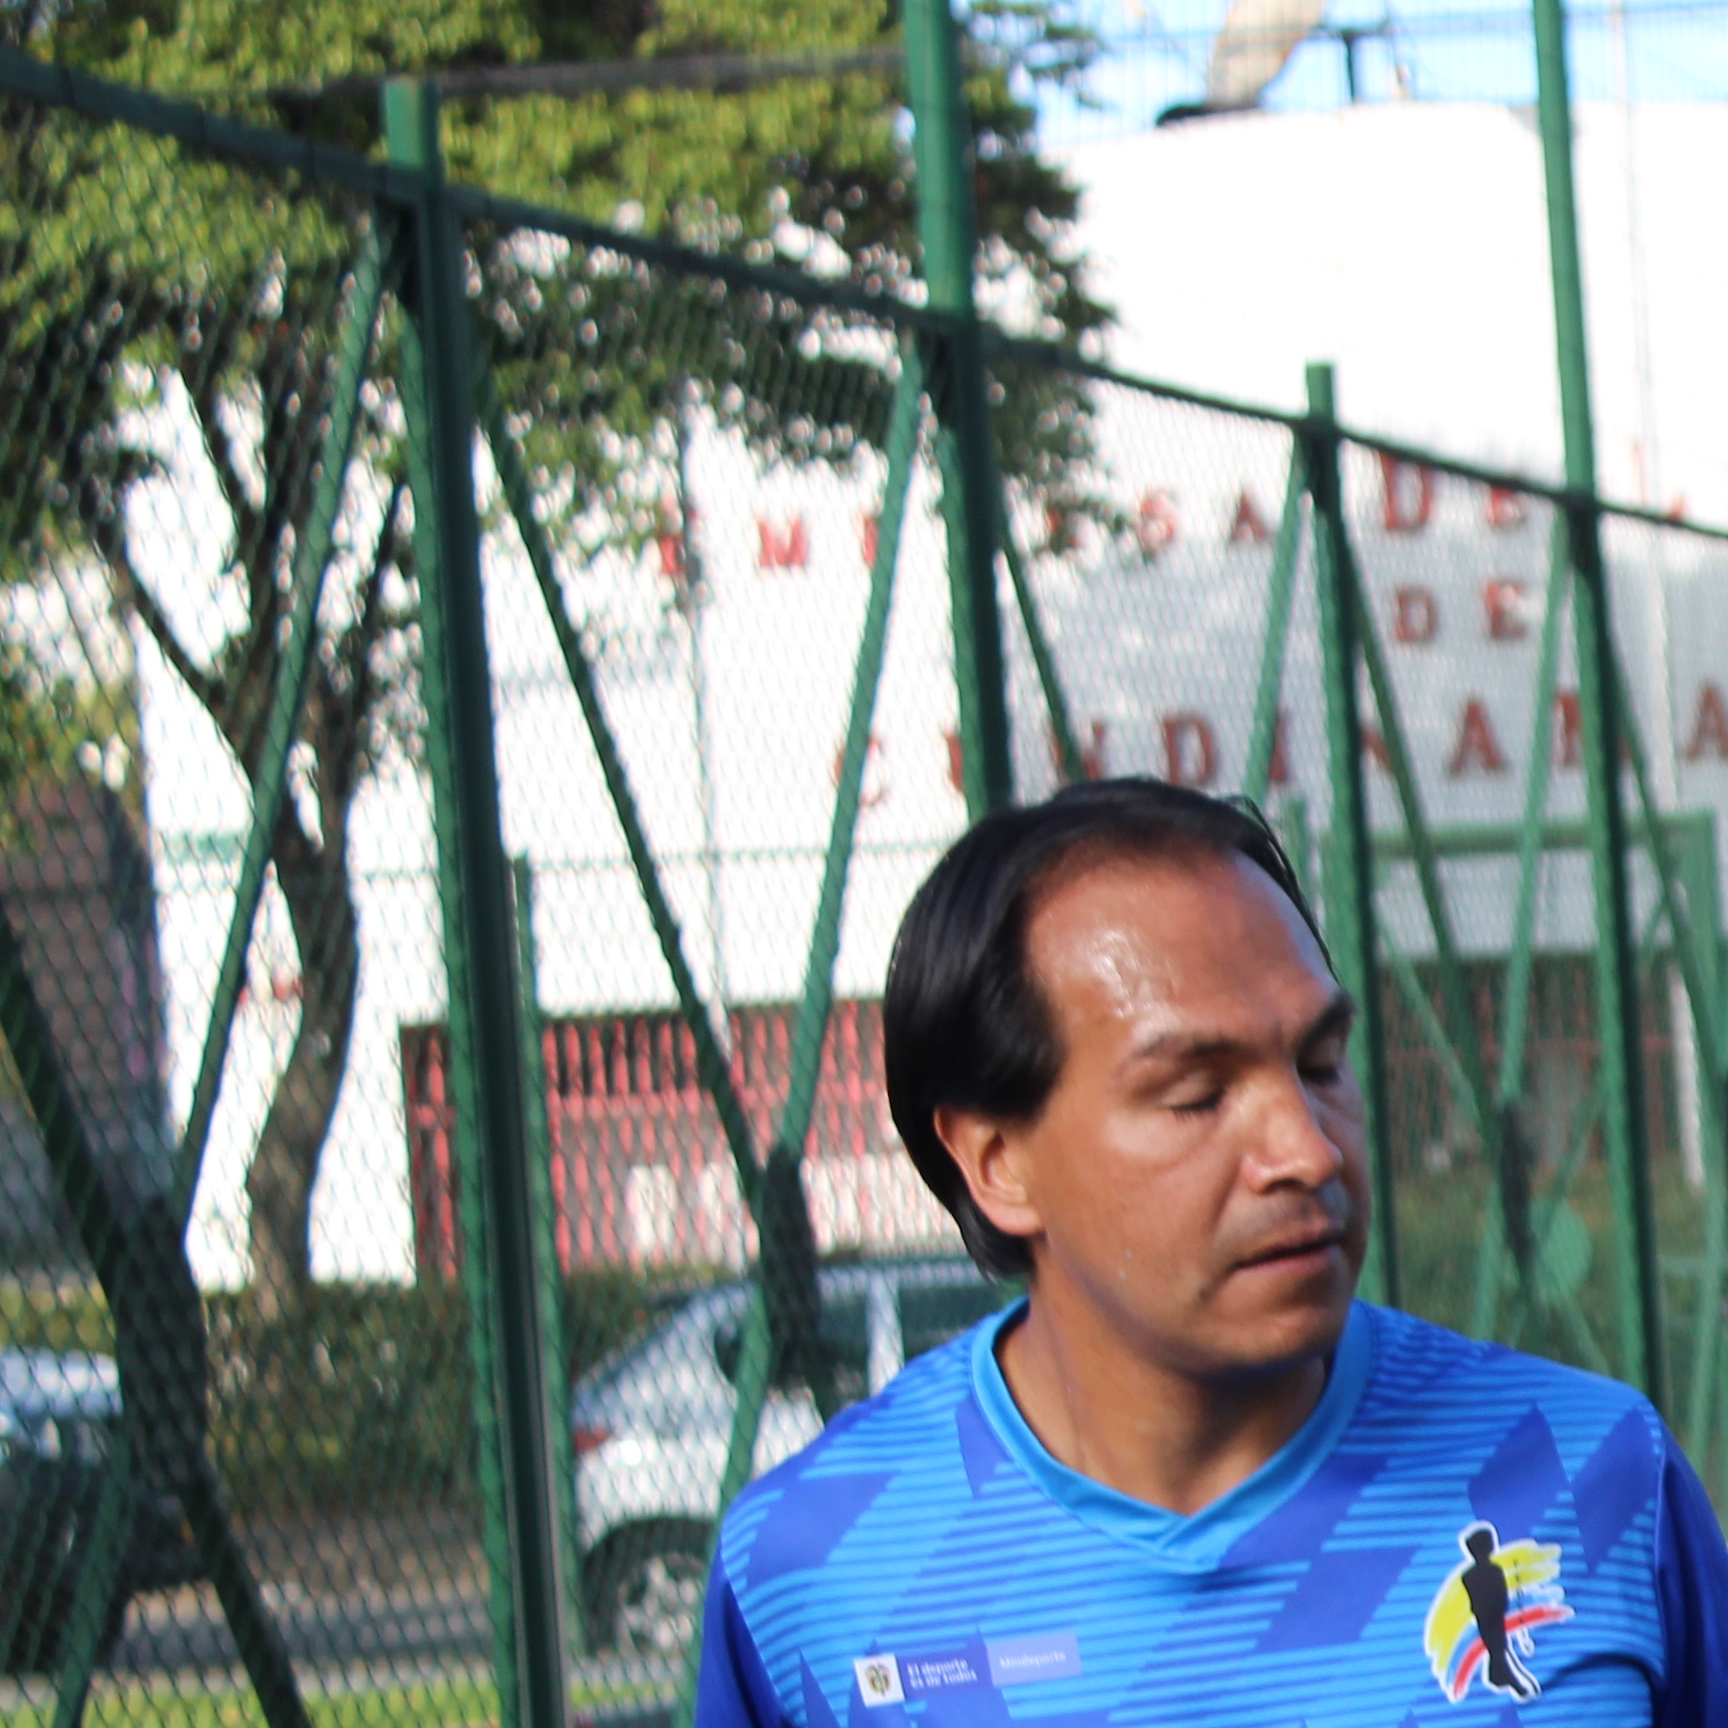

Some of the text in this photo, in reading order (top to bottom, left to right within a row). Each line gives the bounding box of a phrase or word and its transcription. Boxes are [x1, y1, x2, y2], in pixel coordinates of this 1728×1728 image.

[1376, 448, 1530, 533] DE
[1394, 578, 1528, 643] DE
[921, 1657, 969, 1678] deporte
[999, 1649, 1067, 1670] Mindeporte
